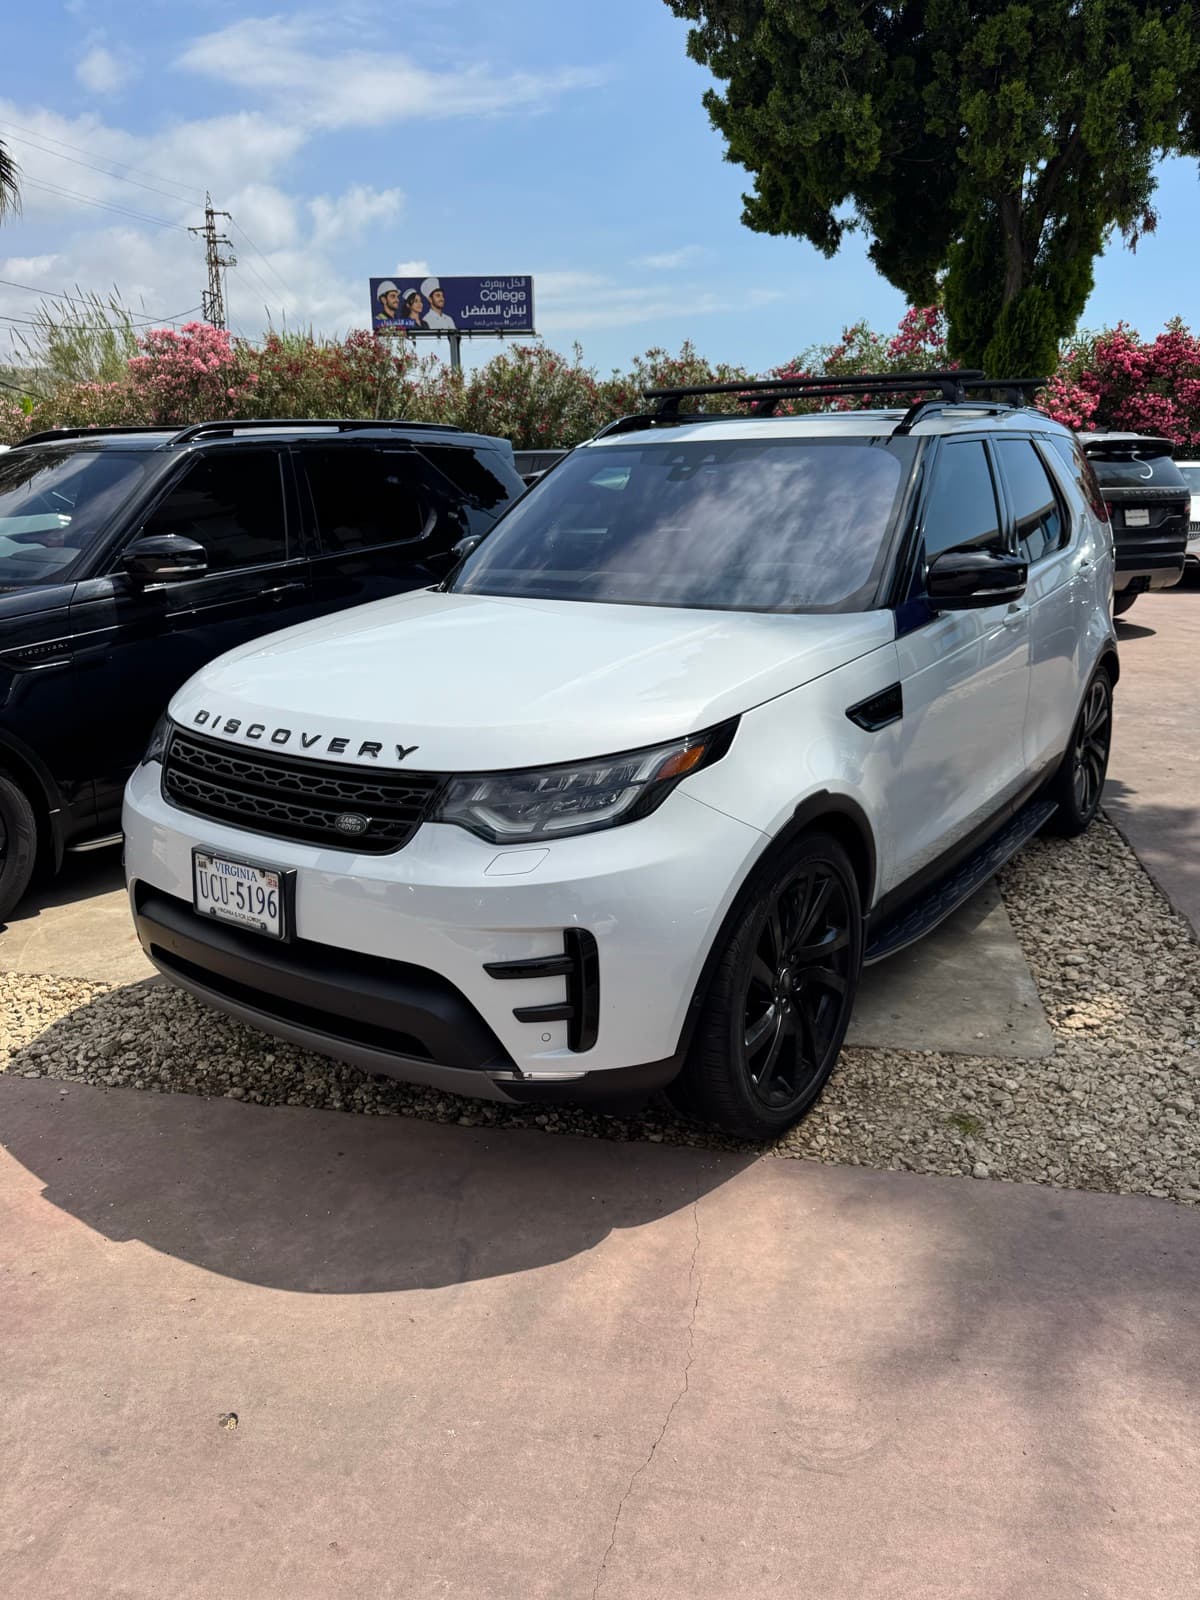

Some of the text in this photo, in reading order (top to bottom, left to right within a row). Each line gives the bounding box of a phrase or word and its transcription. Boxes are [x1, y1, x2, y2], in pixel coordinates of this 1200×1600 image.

[506, 277, 526, 289] الكل
[480, 289, 526, 303] College
[461, 304, 527, 319] لبنان المفضل
[193, 709, 420, 760] DISCOVERY
[340, 816, 357, 825] LAND
[341, 822, 361, 832] ROVER
[214, 861, 258, 883] VIRGINIA
[199, 871, 277, 919] UCU-5196
